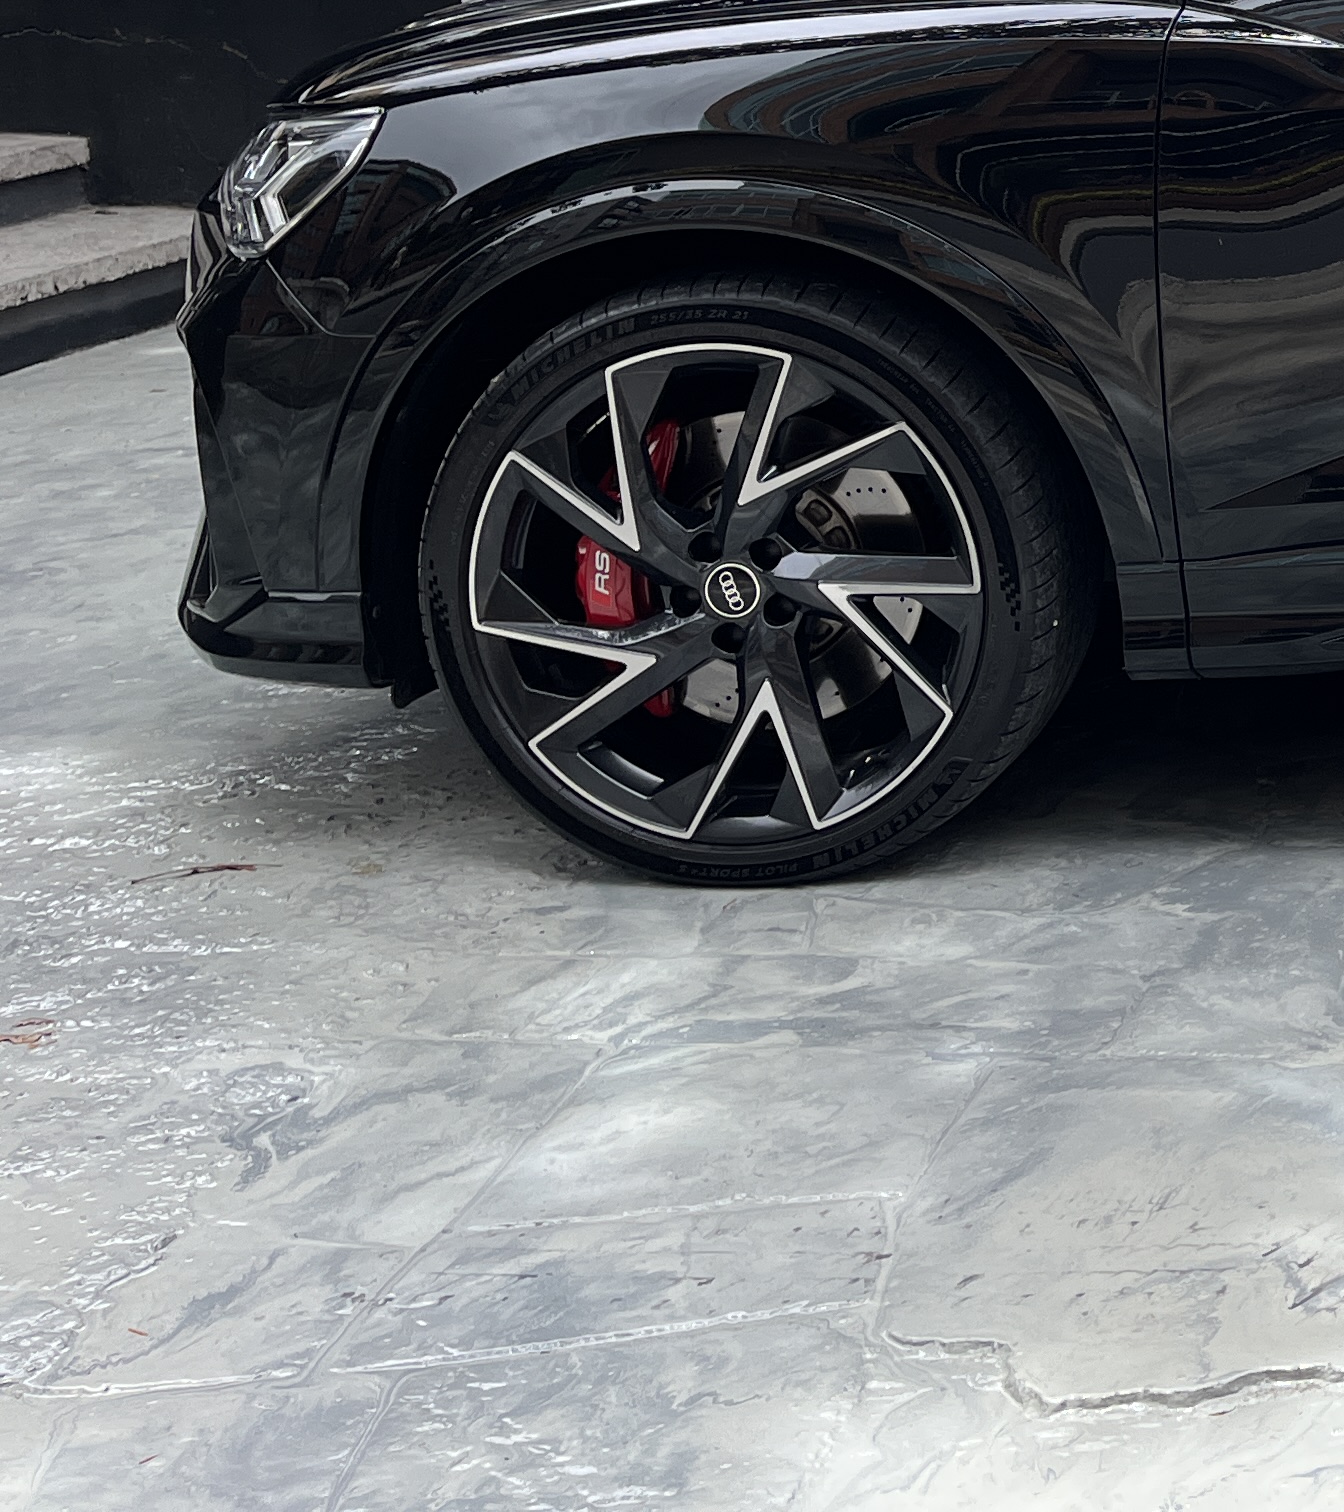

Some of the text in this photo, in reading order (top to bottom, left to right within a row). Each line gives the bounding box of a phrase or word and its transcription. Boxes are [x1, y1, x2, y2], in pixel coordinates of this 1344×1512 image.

[509, 316, 637, 401] MICHELIN
[595, 550, 610, 595] RS
[811, 787, 939, 869] MICHELIN
